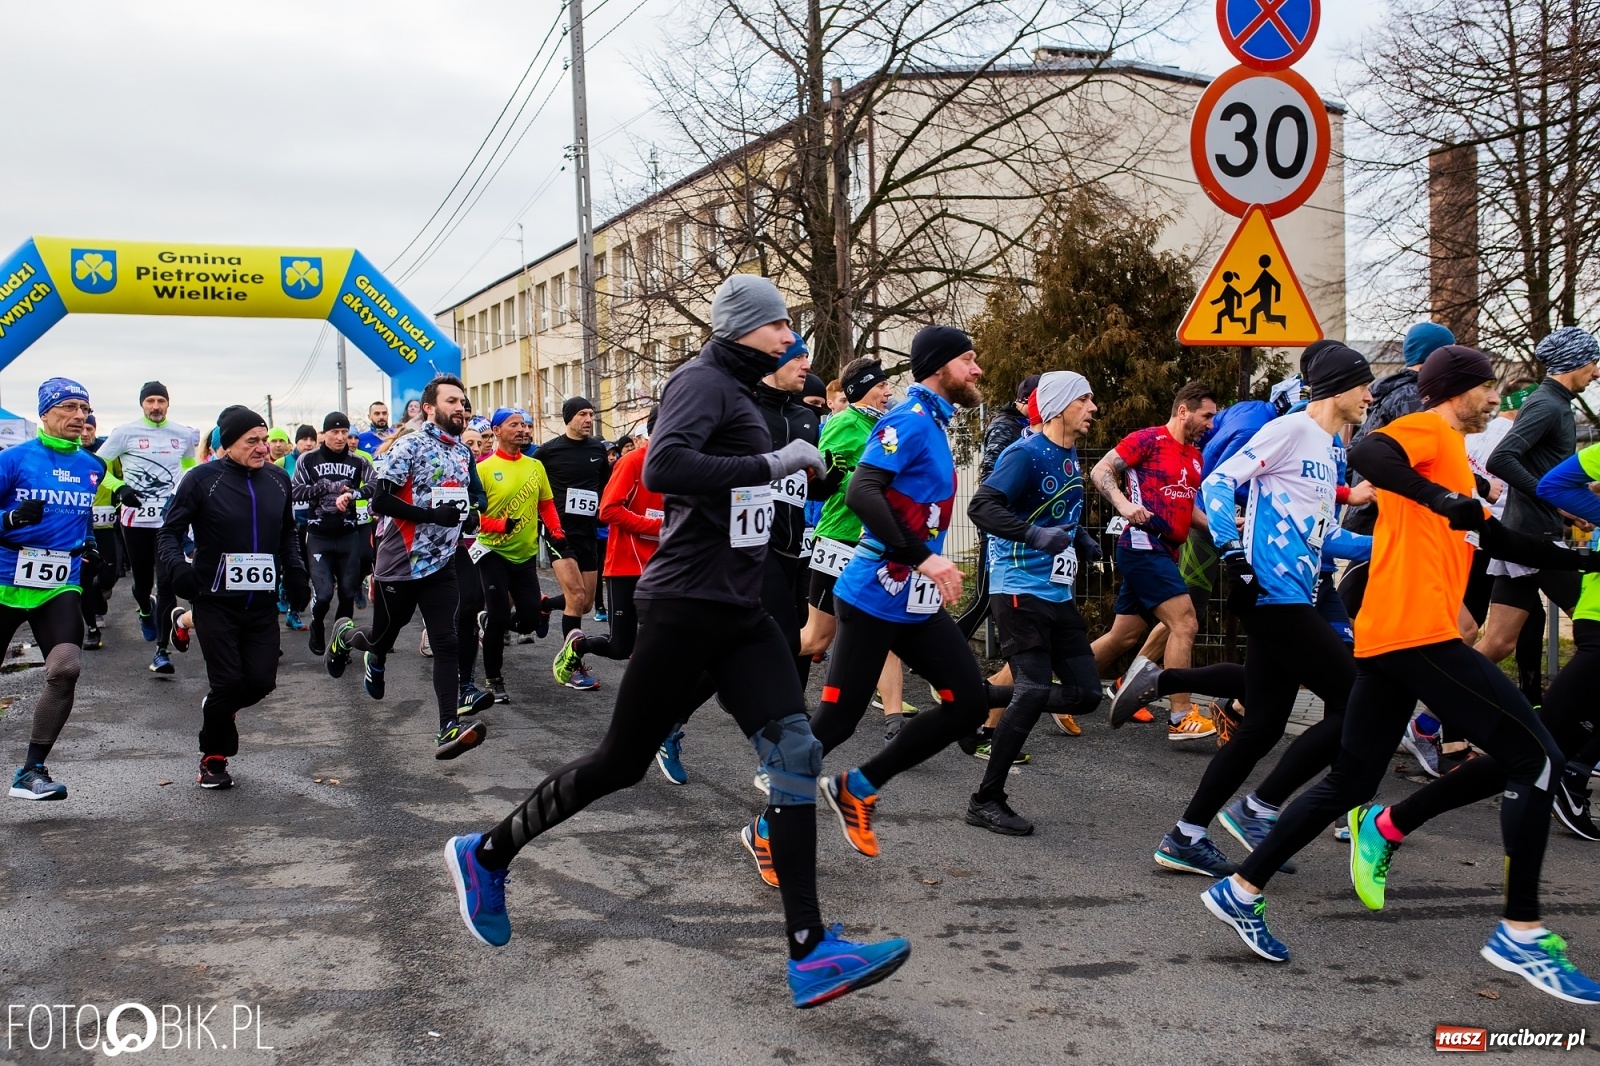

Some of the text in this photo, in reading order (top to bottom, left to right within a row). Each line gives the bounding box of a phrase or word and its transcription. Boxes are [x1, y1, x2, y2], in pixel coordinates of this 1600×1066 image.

[1215, 101, 1308, 179] 30
[158, 251, 242, 266] Gmina
[136, 266, 265, 284] Pietrowice
[153, 285, 248, 301] Wielkie
[355, 274, 436, 352] Gmina ludzi
[342, 292, 418, 364] aktywnych
[53, 468, 70, 477] eko
[58, 473, 80, 484] okna
[313, 462, 357, 479] VENUM
[770, 479, 806, 500] 464
[137, 506, 164, 518] 287
[569, 498, 597, 512] 155
[93, 513, 115, 523] 318
[736, 506, 773, 536] 103
[814, 548, 850, 572] 313
[21, 561, 68, 582] 150
[229, 566, 274, 584] 366
